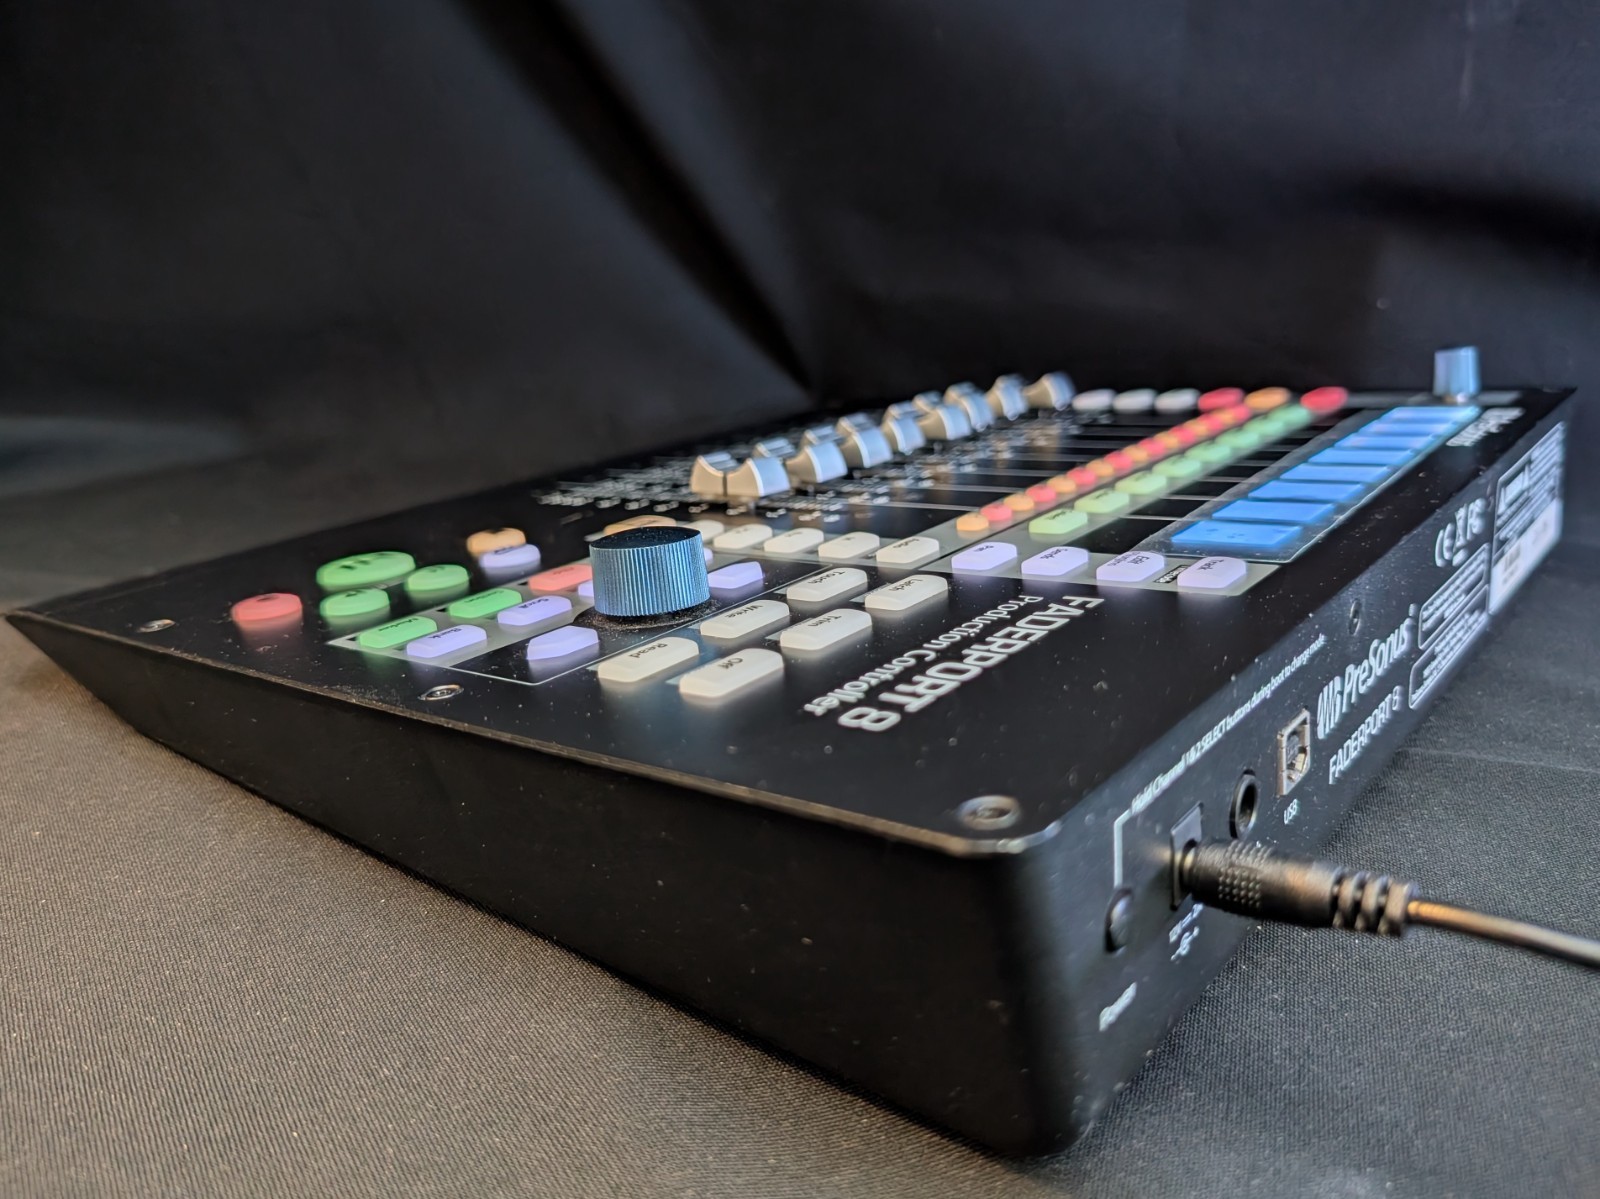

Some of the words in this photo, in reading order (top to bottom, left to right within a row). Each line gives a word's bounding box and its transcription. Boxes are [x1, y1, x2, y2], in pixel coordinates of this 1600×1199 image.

[1128, 555, 1151, 566] Edit
[1197, 558, 1226, 571] Track
[807, 570, 847, 585] Touch
[888, 578, 924, 592] Latch
[725, 604, 766, 619] Write
[807, 614, 846, 628] Trim
[922, 594, 1044, 650] Production
[429, 628, 463, 640] Bank
[628, 642, 669, 659] Read
[878, 595, 1105, 713] FADERPORT
[717, 656, 745, 671] Off
[1342, 617, 1415, 714] PreSonus
[803, 649, 937, 717] Controller
[837, 706, 902, 732] 8
[1152, 755, 1186, 797] Channel
[1200, 718, 1226, 752] SELECT
[1226, 701, 1251, 731] buttons
[1250, 682, 1271, 708] during
[1270, 668, 1284, 690] boot
[1290, 650, 1310, 674] change
[1309, 633, 1326, 656] mode
[1329, 693, 1393, 785] FADERPORT
[1391, 685, 1405, 712] 8
[1284, 798, 1298, 825] USB
